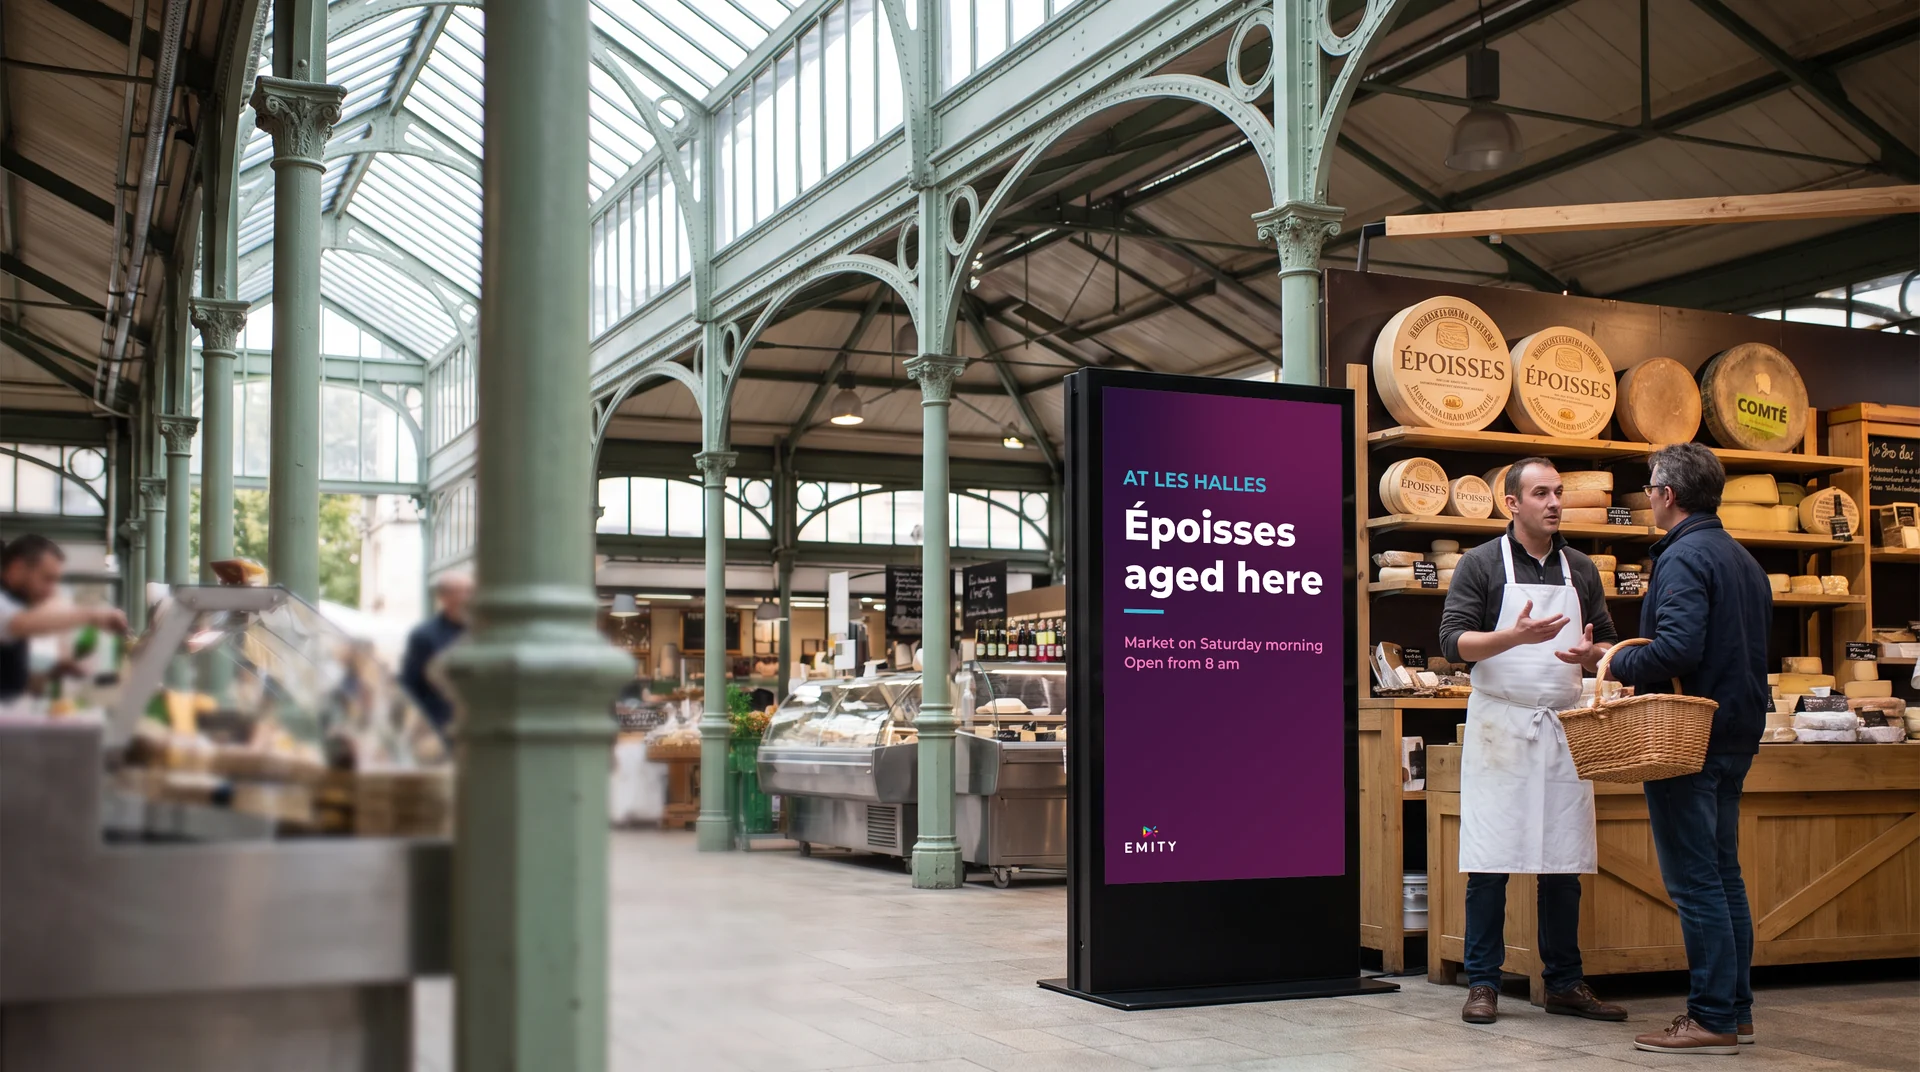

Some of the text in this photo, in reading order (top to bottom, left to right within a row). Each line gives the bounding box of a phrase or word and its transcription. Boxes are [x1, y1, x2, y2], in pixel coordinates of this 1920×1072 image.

[1400, 345, 1505, 380] ÉPOISSES
[1525, 364, 1611, 400] ÉPOISSES
[1738, 398, 1787, 424] COMTÉ
[1123, 469, 1267, 493] AT LES HALLES
[1126, 500, 1296, 549] Époisses
[1125, 559, 1323, 599] aged here
[1125, 635, 1323, 655] Market on Saturday morning
[1125, 656, 1240, 672] Open from 8 am
[1125, 841, 1177, 854] EMITY
